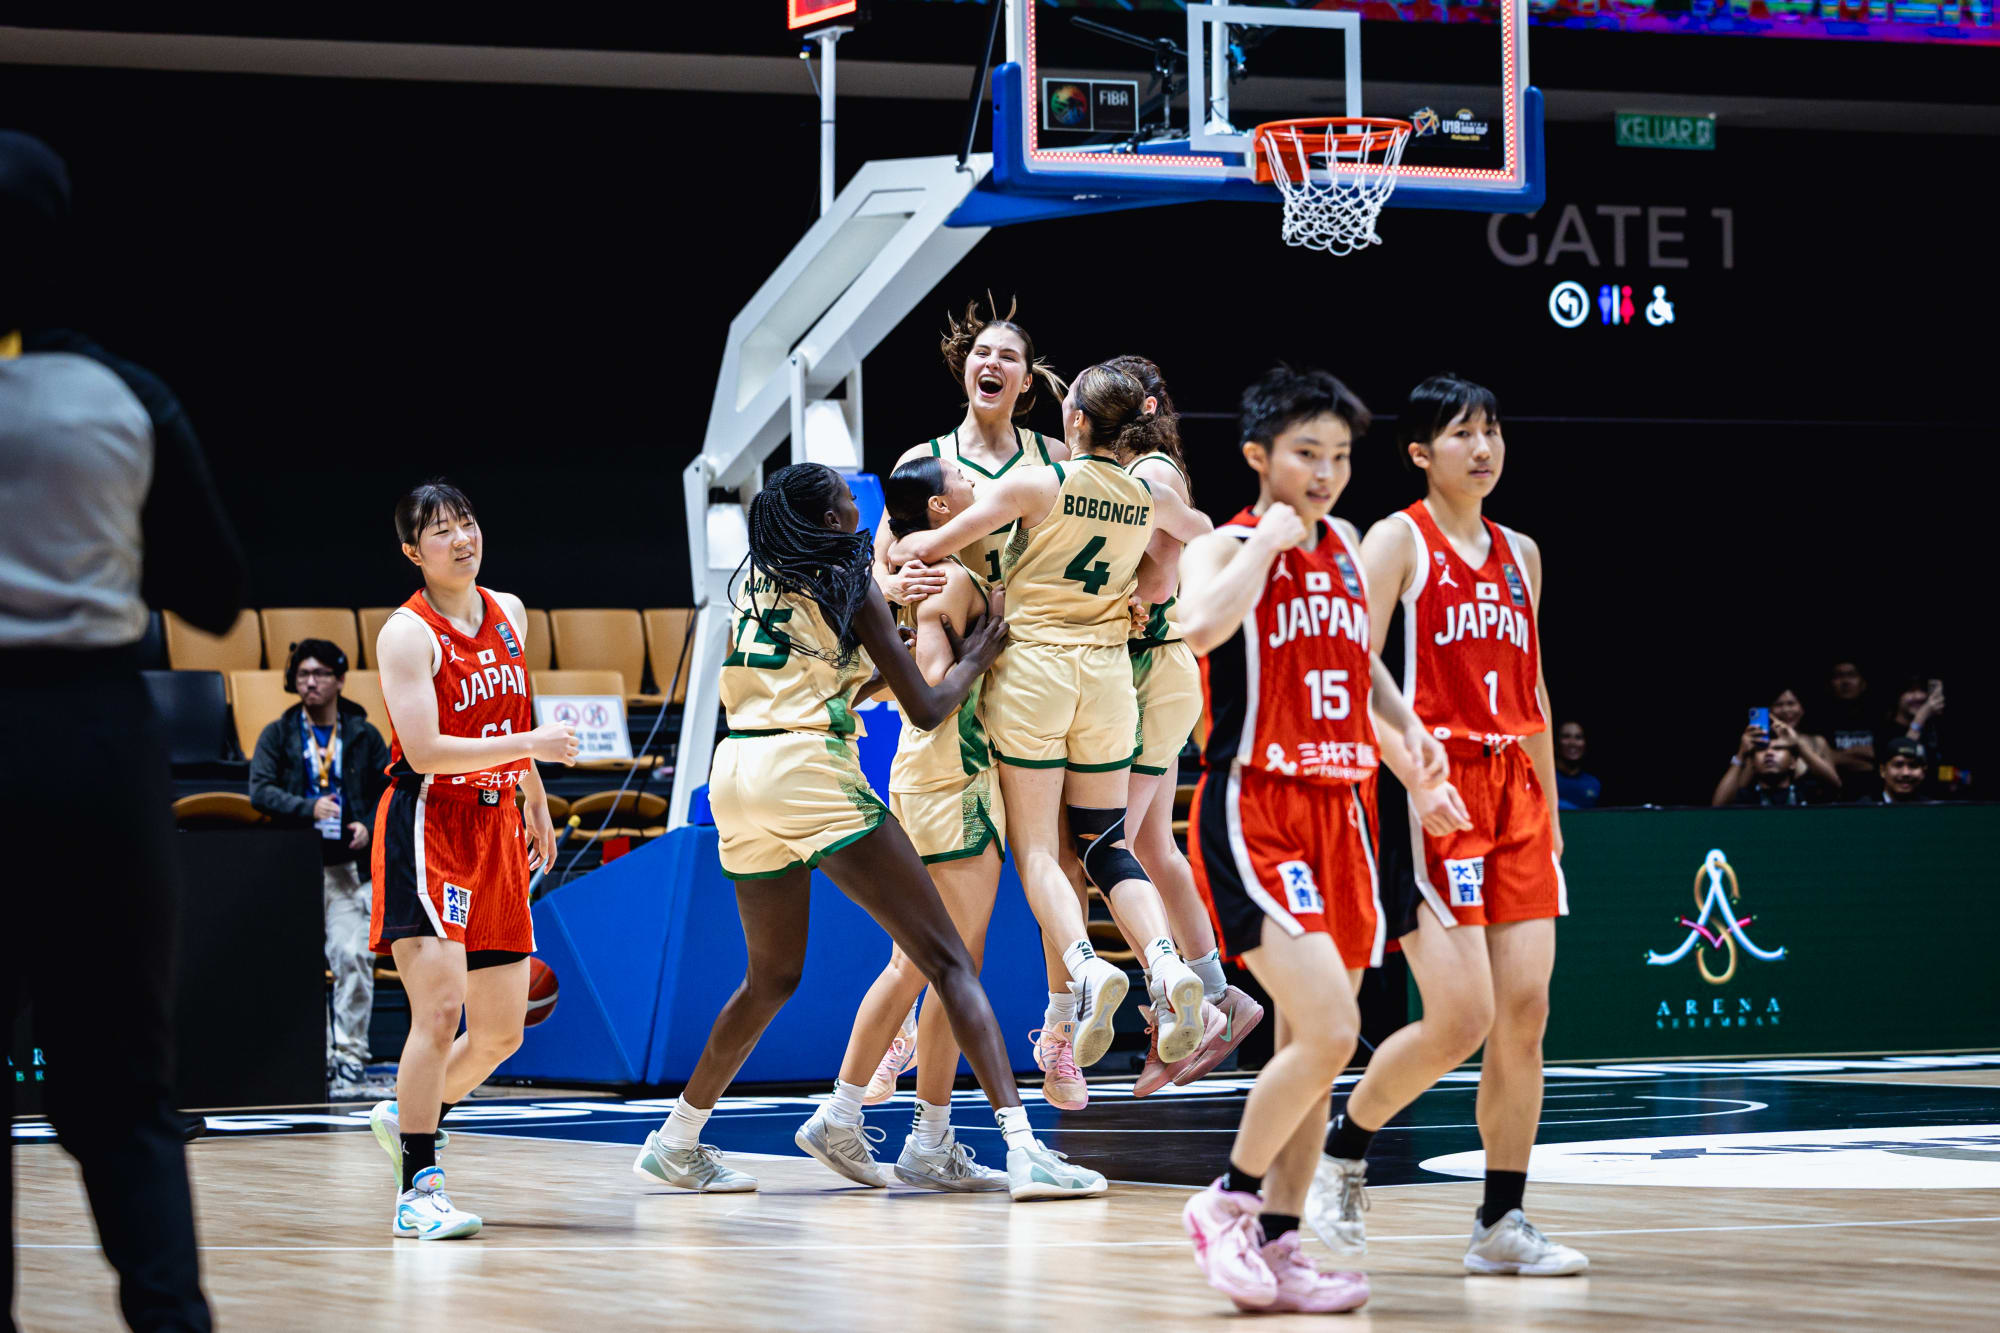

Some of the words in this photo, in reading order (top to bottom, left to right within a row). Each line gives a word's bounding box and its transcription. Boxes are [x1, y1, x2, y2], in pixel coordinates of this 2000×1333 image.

[1099, 90, 1129, 106] FIBA
[1619, 116, 1694, 144] KELUAR
[1486, 204, 1689, 268] GATE
[1710, 207, 1735, 270] 1
[1063, 494, 1150, 526] BOBONGIE
[1062, 535, 1111, 596] 4
[722, 607, 794, 670] 15
[1268, 594, 1369, 653] JAPAN
[1434, 601, 1529, 655] JAPAN
[453, 664, 527, 712] JAPAN
[1303, 669, 1350, 720] 15
[1483, 670, 1499, 716] 1
[447, 886, 460, 923] 大吉
[1656, 997, 1781, 1017] ARENA
